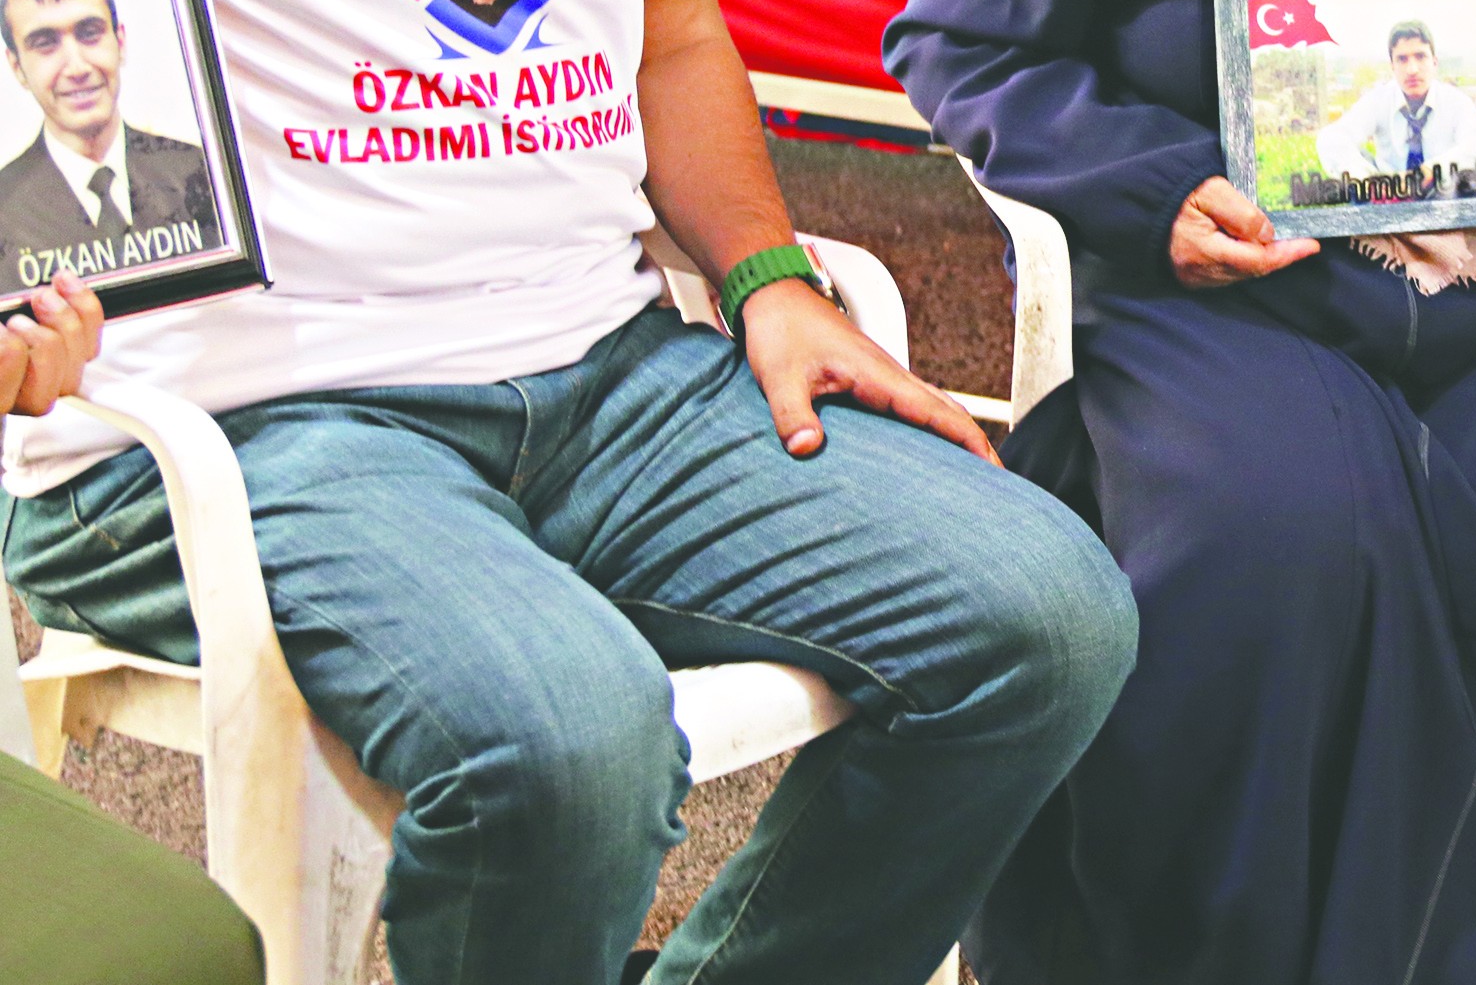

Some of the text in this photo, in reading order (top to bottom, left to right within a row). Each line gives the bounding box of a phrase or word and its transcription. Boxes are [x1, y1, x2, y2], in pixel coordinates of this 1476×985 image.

[352, 49, 614, 114] ÖZKAN AYDIN
[283, 123, 490, 164] EVLADIMI
[1290, 170, 1425, 207] Mahmut
[18, 219, 204, 288] ÖZKAN AYDIN
